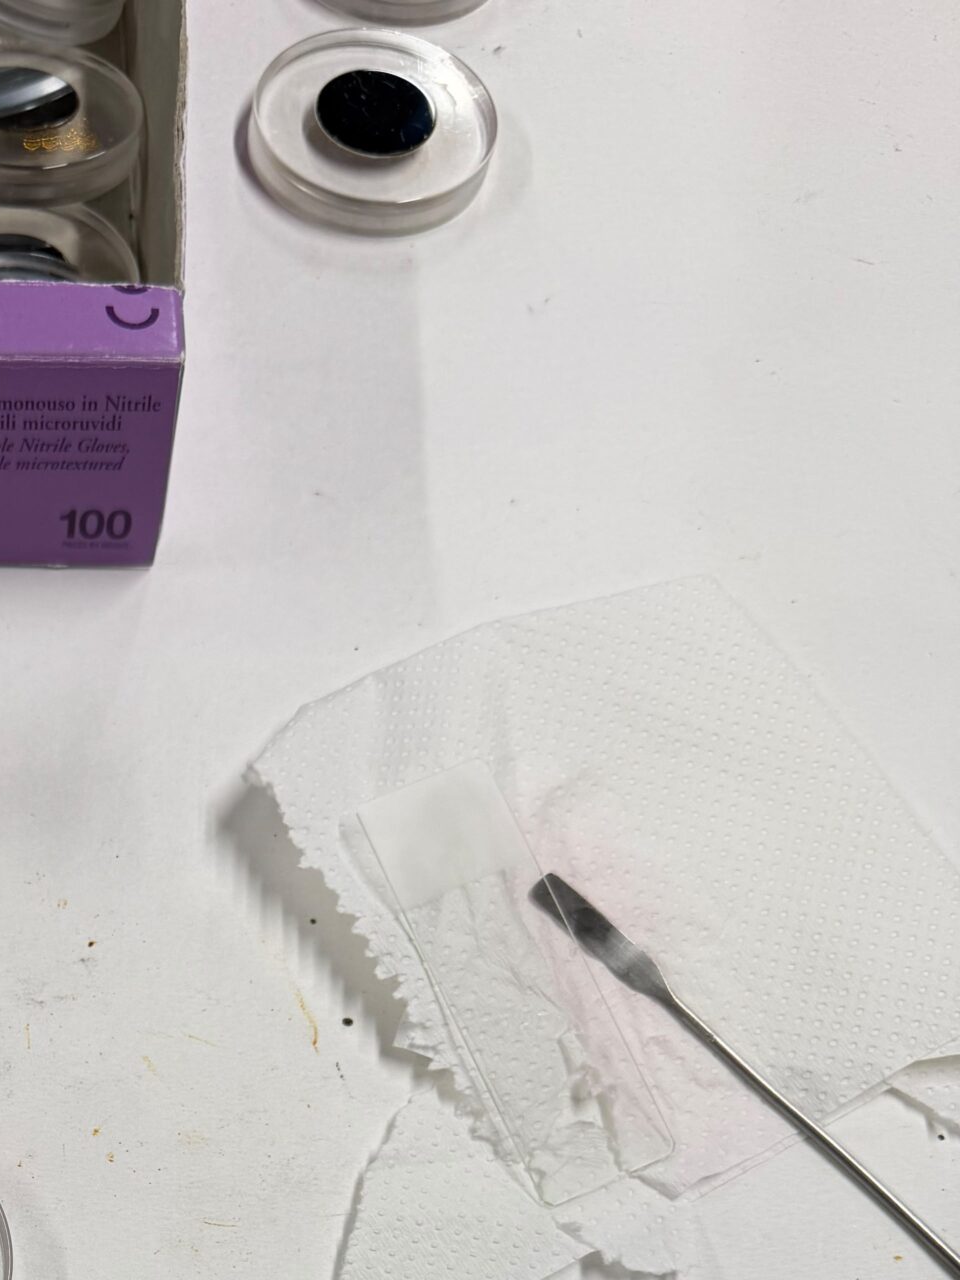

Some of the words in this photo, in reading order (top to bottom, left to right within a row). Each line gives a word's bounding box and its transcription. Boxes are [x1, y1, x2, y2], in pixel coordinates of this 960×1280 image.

[82, 395, 99, 412] in
[105, 395, 161, 413] Nitrile
[23, 413, 123, 432] microruvidi
[19, 437, 72, 454] Nitrile
[16, 456, 126, 471] microtextured
[60, 508, 133, 540] 100
